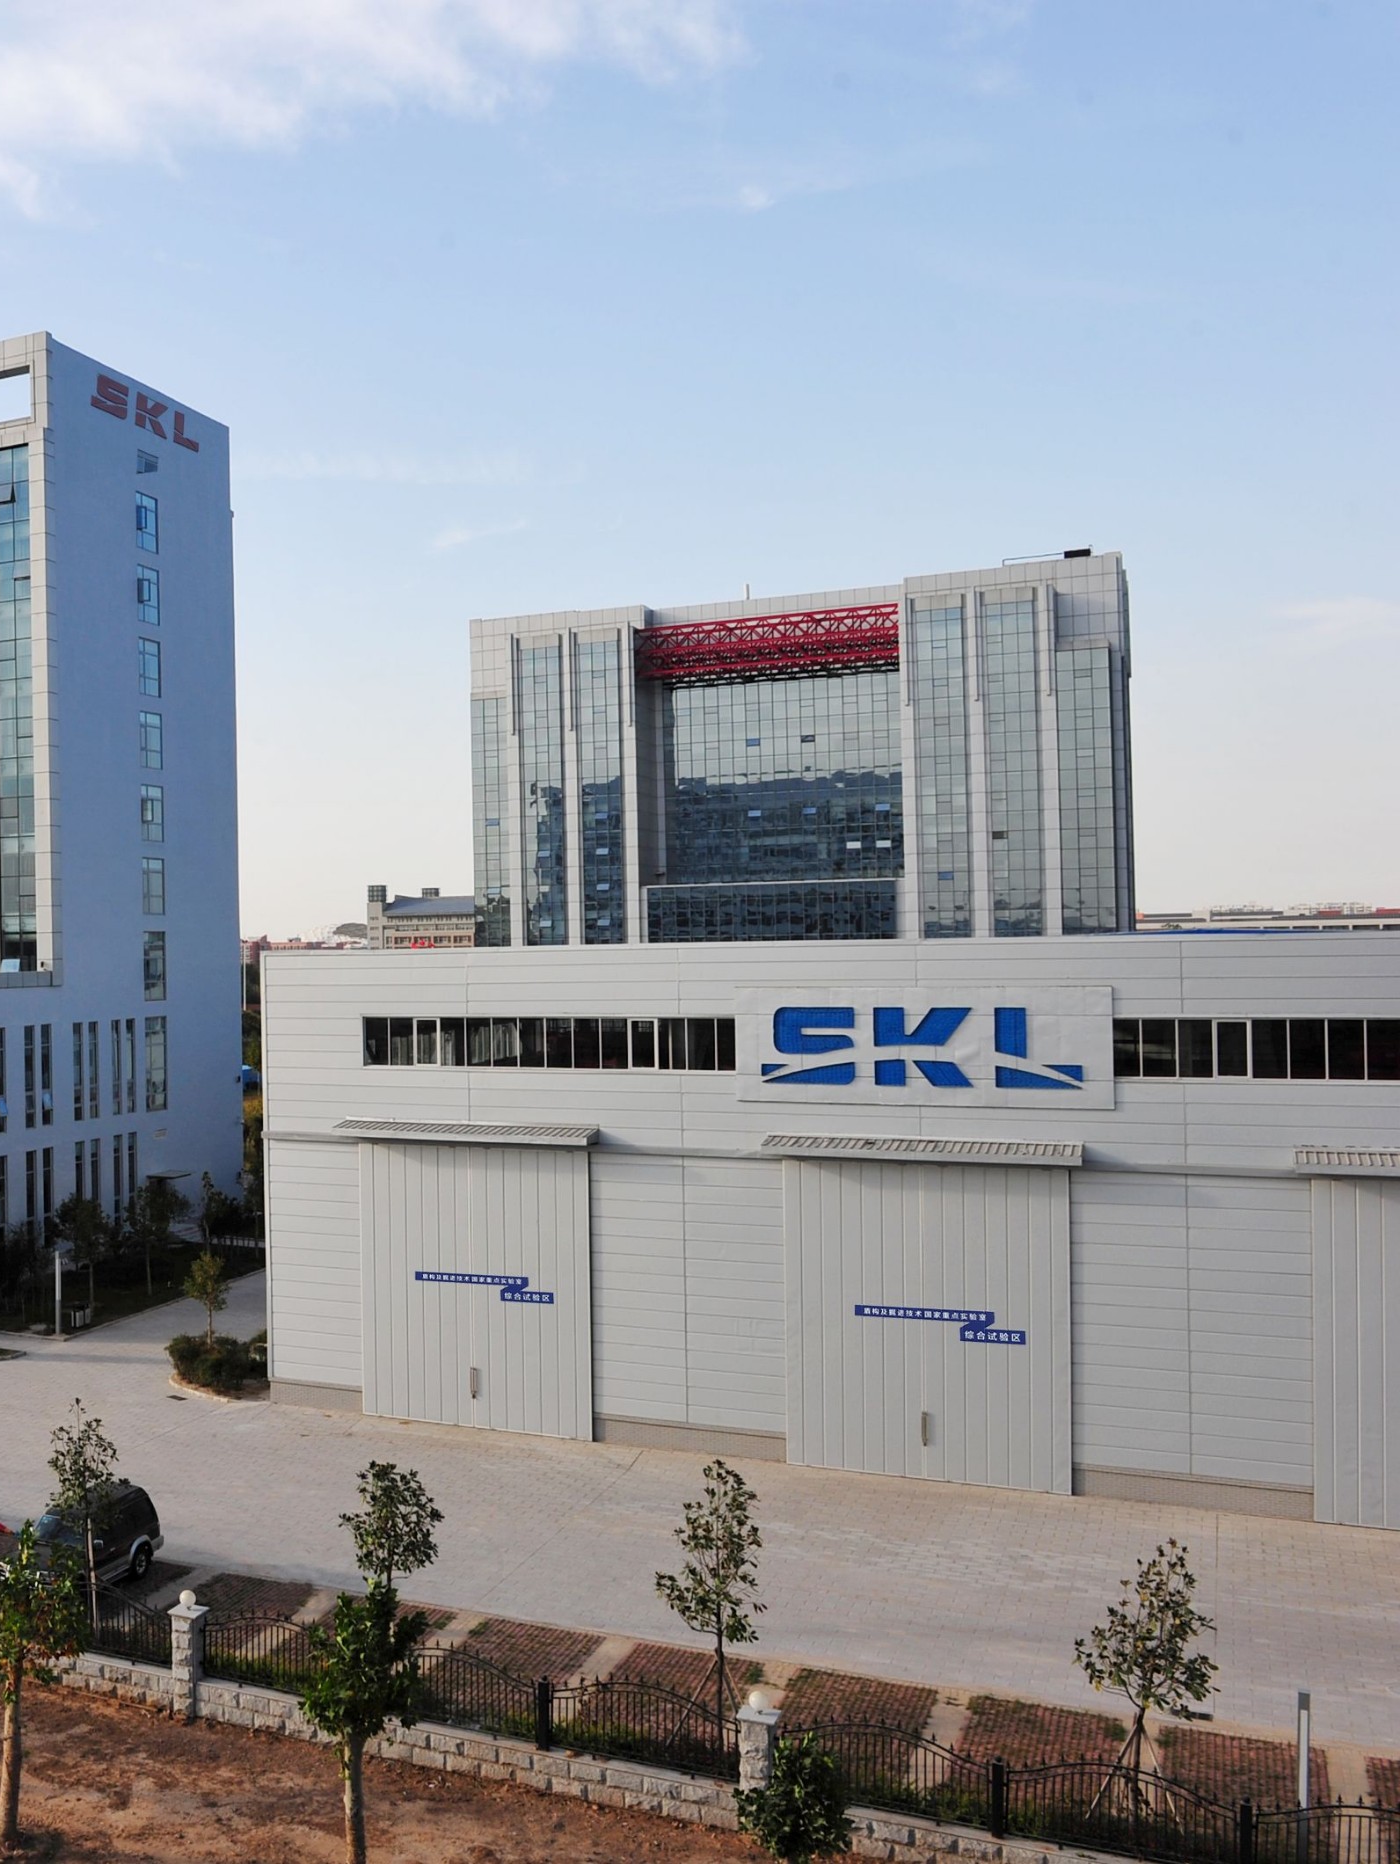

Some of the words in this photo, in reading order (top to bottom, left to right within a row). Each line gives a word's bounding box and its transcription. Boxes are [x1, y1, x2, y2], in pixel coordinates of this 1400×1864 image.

[91, 373, 199, 453] SKL
[761, 1006, 1083, 1089] SKL
[422, 1273, 522, 1285] 盾构及掘进技术国家重点实验室
[504, 1292, 550, 1302] 综合试验区
[863, 1307, 987, 1321] 盾构及掘进技术国家重点实验室
[964, 1330, 1021, 1342] 综合试验区
